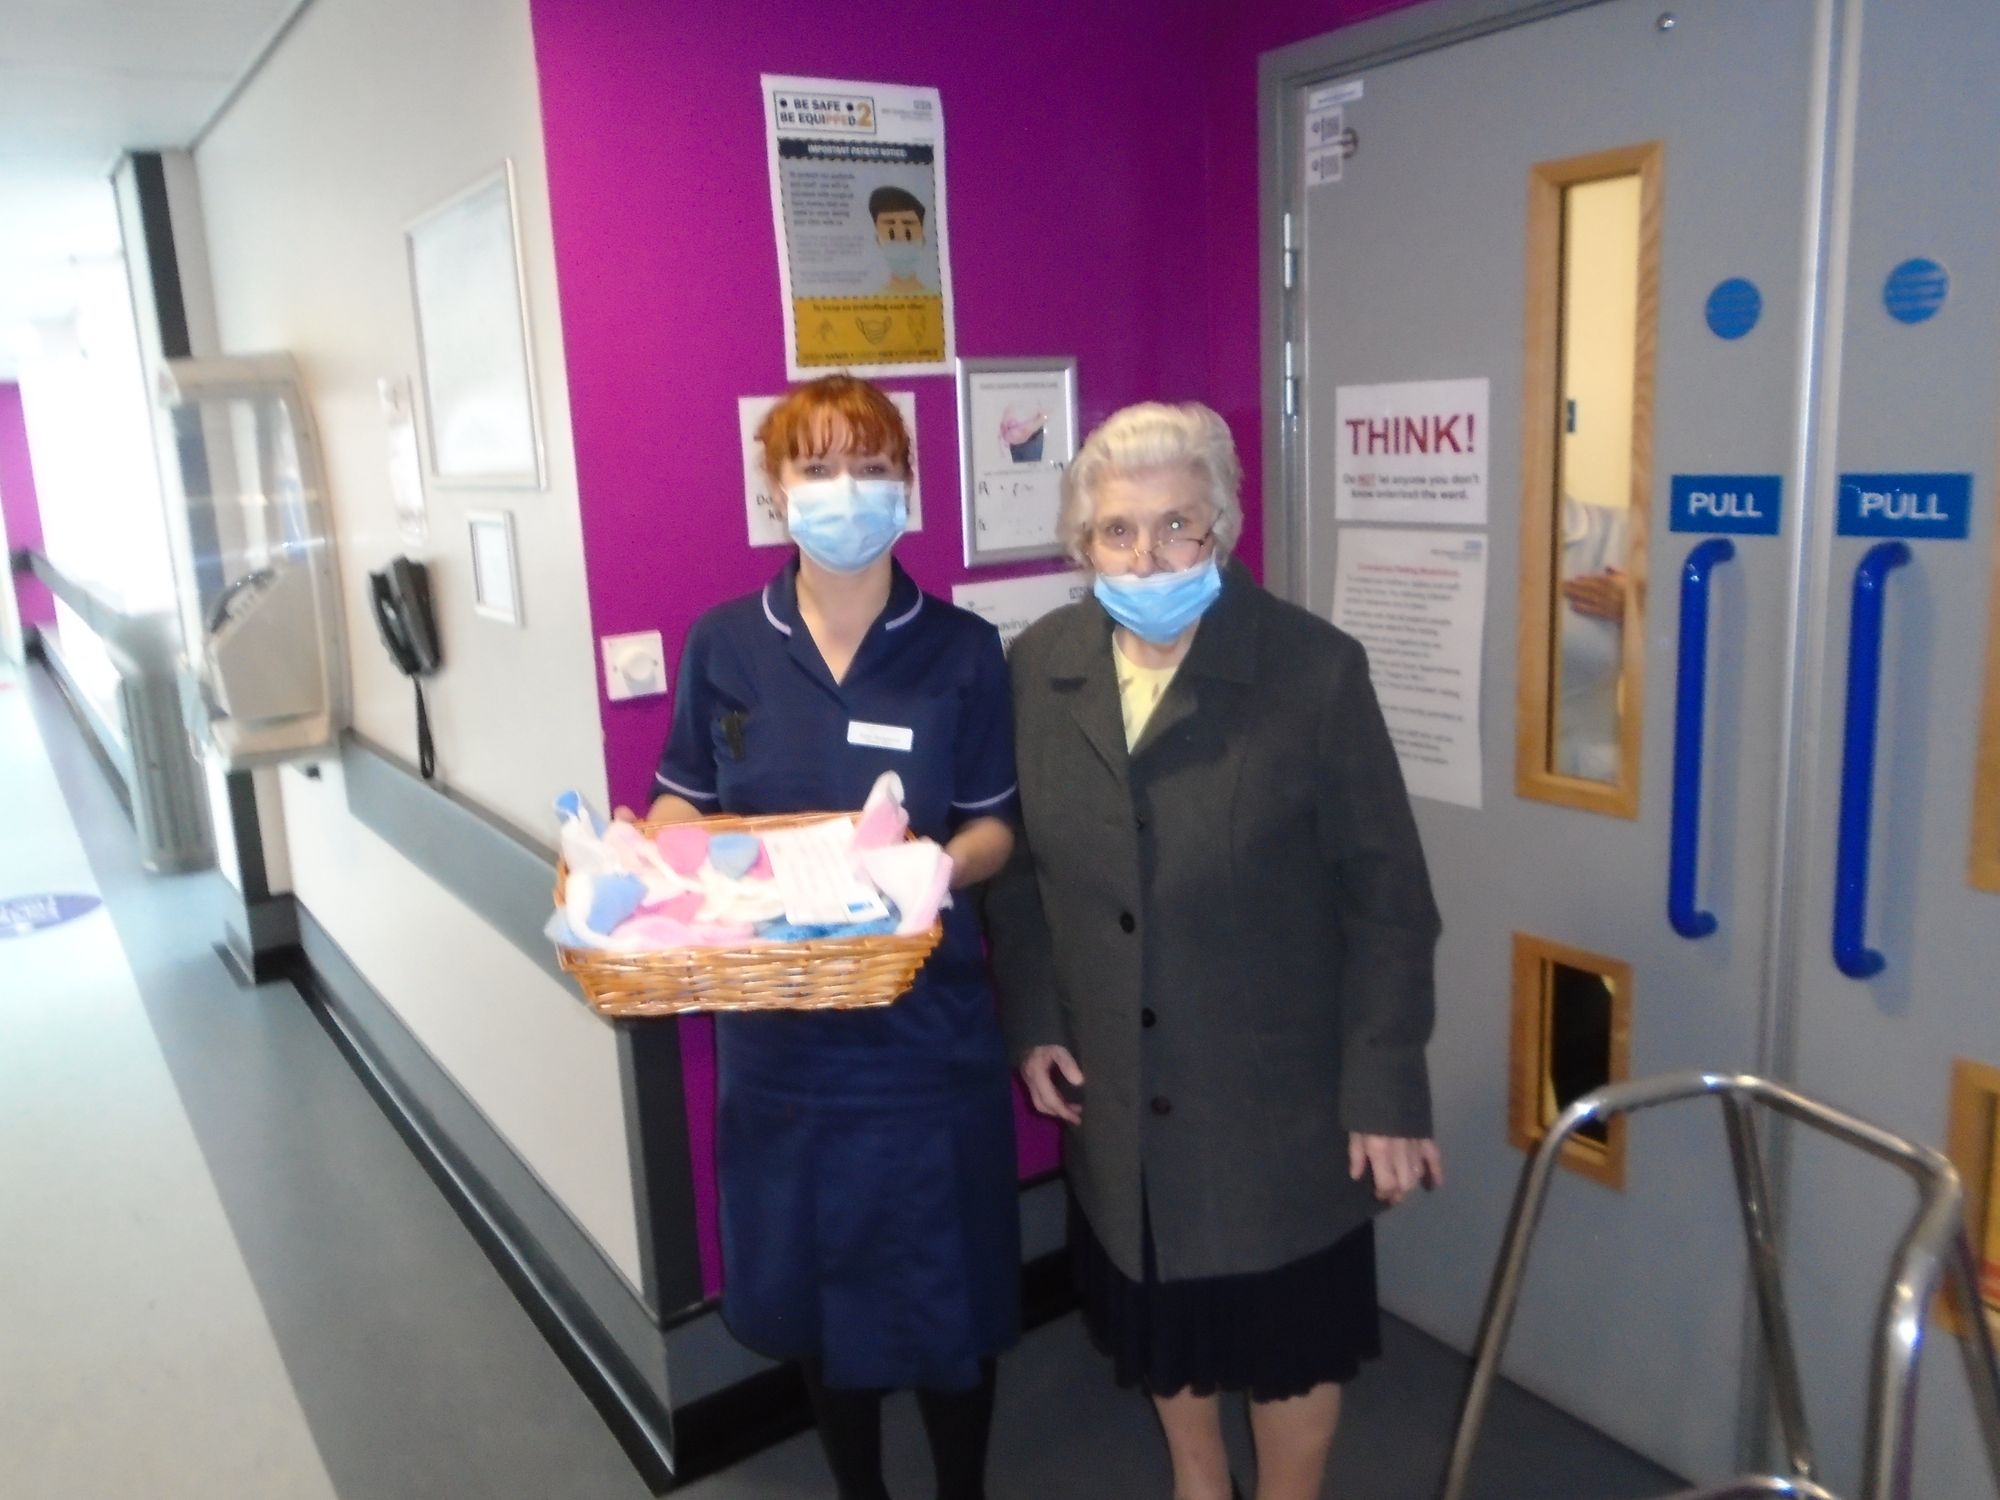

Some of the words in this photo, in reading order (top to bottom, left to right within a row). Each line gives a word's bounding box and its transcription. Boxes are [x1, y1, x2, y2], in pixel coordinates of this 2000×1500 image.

[794, 99, 809, 109] BE
[812, 100, 841, 112] SAFE
[857, 102, 872, 127] 2
[780, 112, 795, 123] BE
[798, 113, 857, 126] EQUIPPED
[1345, 414, 1474, 455] THINK!
[1429, 475, 1449, 486] you
[1452, 474, 1480, 484] don't
[1688, 492, 1763, 518] PULL
[1858, 492, 1949, 520] PULL
